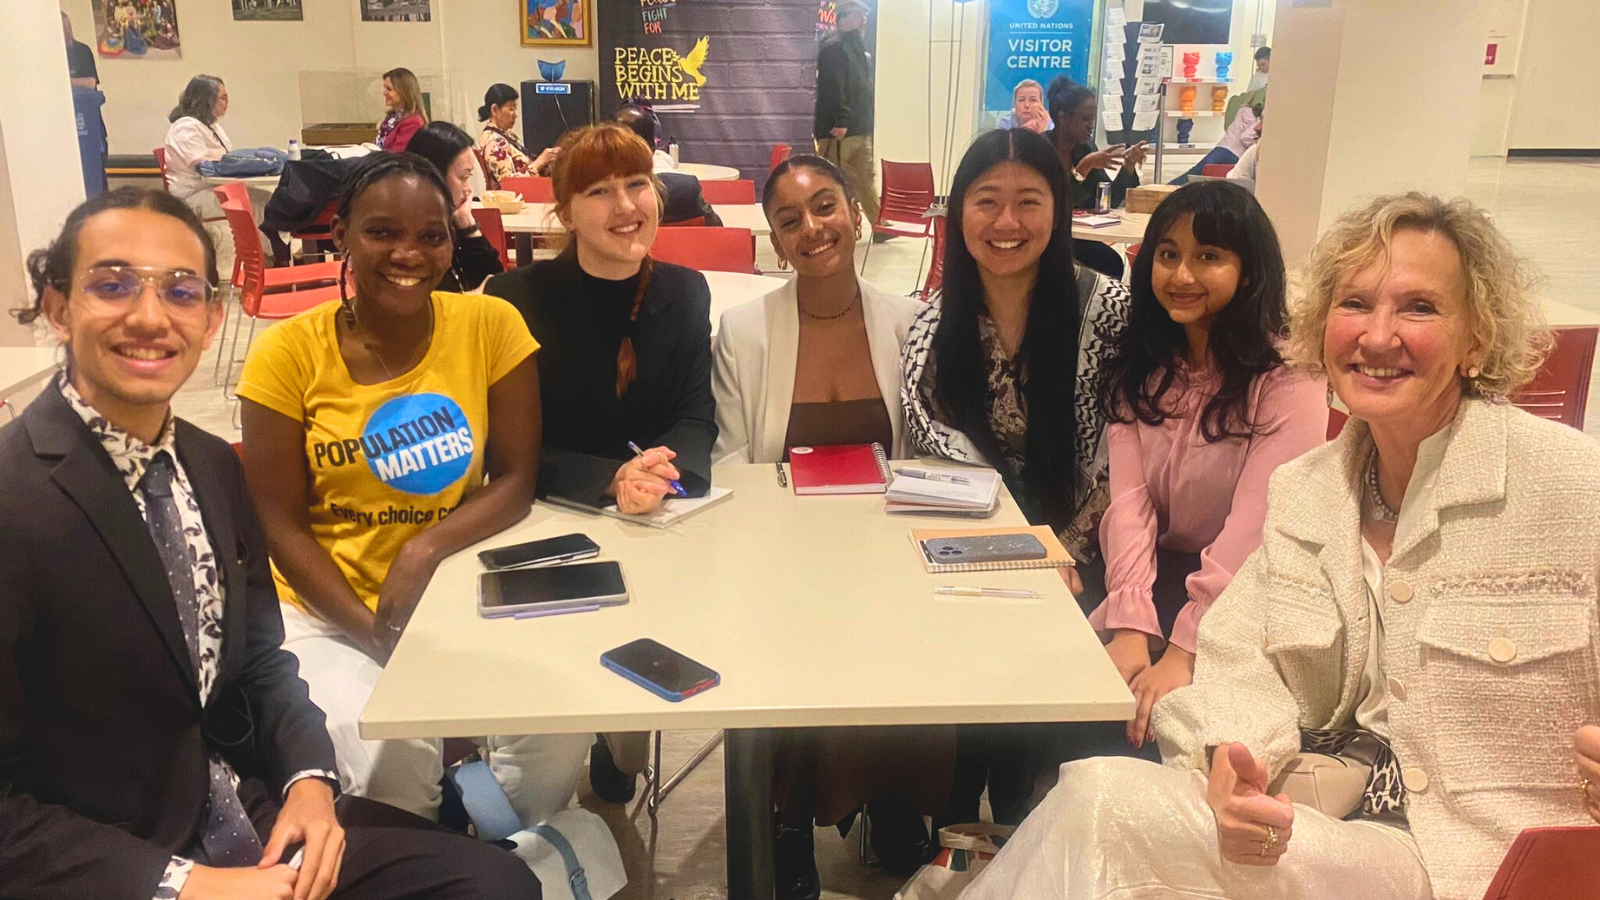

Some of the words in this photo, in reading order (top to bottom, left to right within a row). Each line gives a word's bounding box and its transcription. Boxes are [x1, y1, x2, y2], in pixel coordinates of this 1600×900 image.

[642, 7, 667, 22] FIGHT
[643, 21, 662, 35] FOR
[1008, 38, 1072, 52] VISITOR
[614, 47, 674, 65] PEACE
[1007, 55, 1071, 68] CENTRE
[614, 65, 683, 83] BEGINS
[616, 82, 667, 100] WITH
[671, 82, 700, 100] ME
[313, 406, 456, 468] POPULATION
[374, 427, 475, 482] MATTERS
[330, 502, 373, 527] Every
[378, 506, 434, 526] choice
